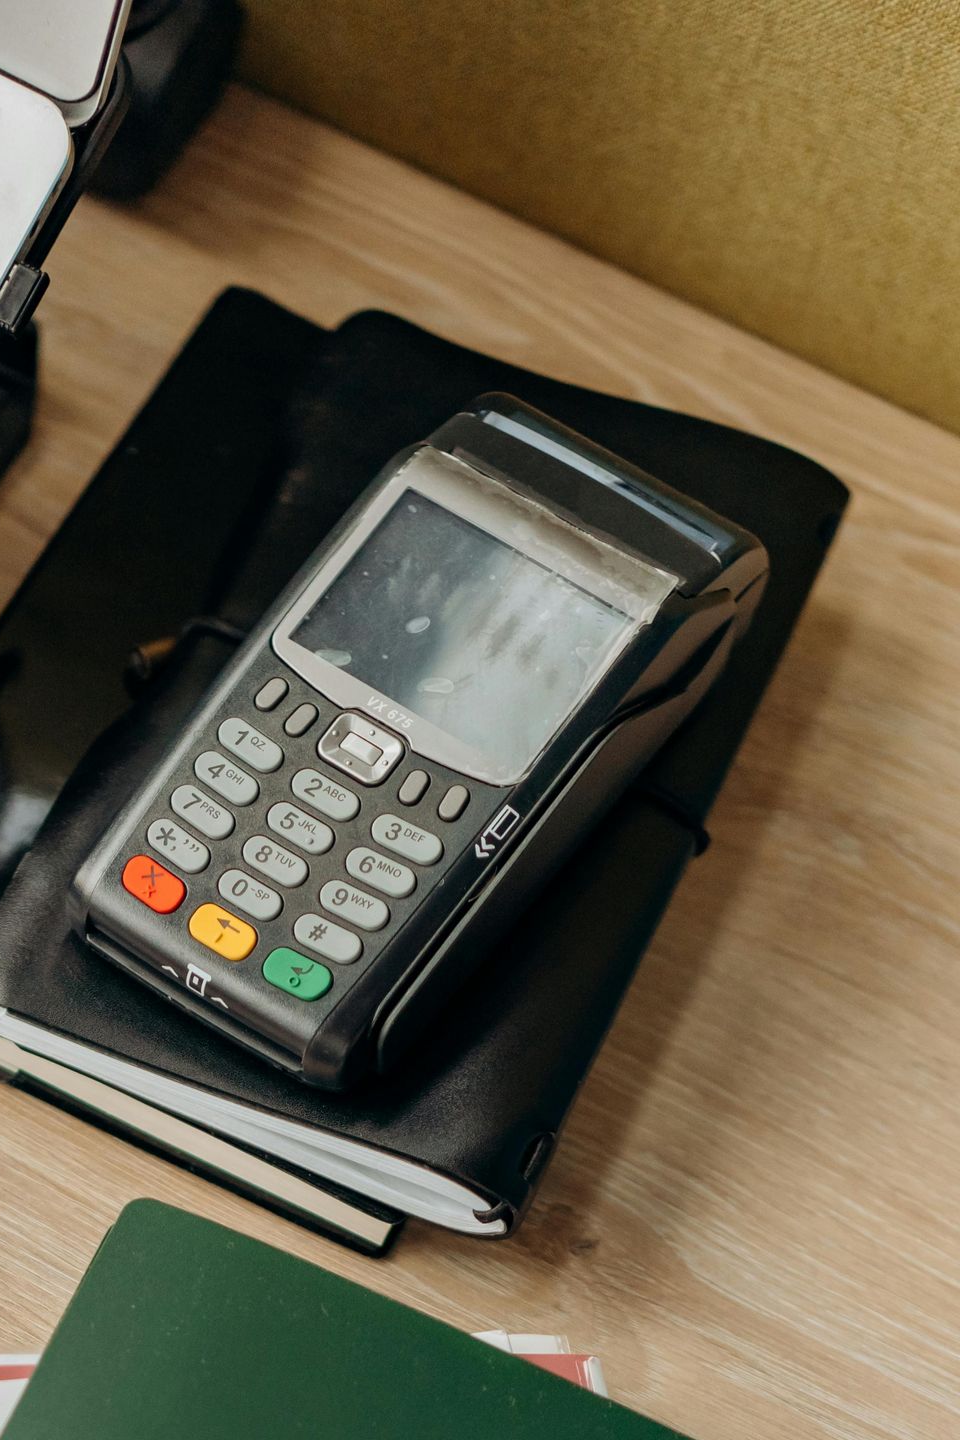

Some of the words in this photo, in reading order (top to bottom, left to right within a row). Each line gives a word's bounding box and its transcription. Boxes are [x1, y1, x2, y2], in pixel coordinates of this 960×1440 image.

[367, 696, 388, 712] VX
[387, 709, 414, 728] 675
[234, 730, 249, 746] 1
[207, 764, 226, 779] 4
[225, 769, 245, 785] GHI
[304, 778, 323, 798] 2
[322, 785, 346, 802] ABC
[183, 792, 203, 810] 7
[199, 801, 221, 820] PRS
[280, 811, 299, 830] 5
[298, 819, 318, 835] JKL
[385, 823, 402, 841] 3
[403, 828, 426, 843] DEF
[255, 845, 273, 864] 8
[274, 852, 297, 869] TUV
[358, 855, 376, 874] 6
[376, 861, 402, 878] MNO
[231, 879, 249, 897] 0
[331, 888, 349, 906] 9
[351, 893, 375, 910] WXY
